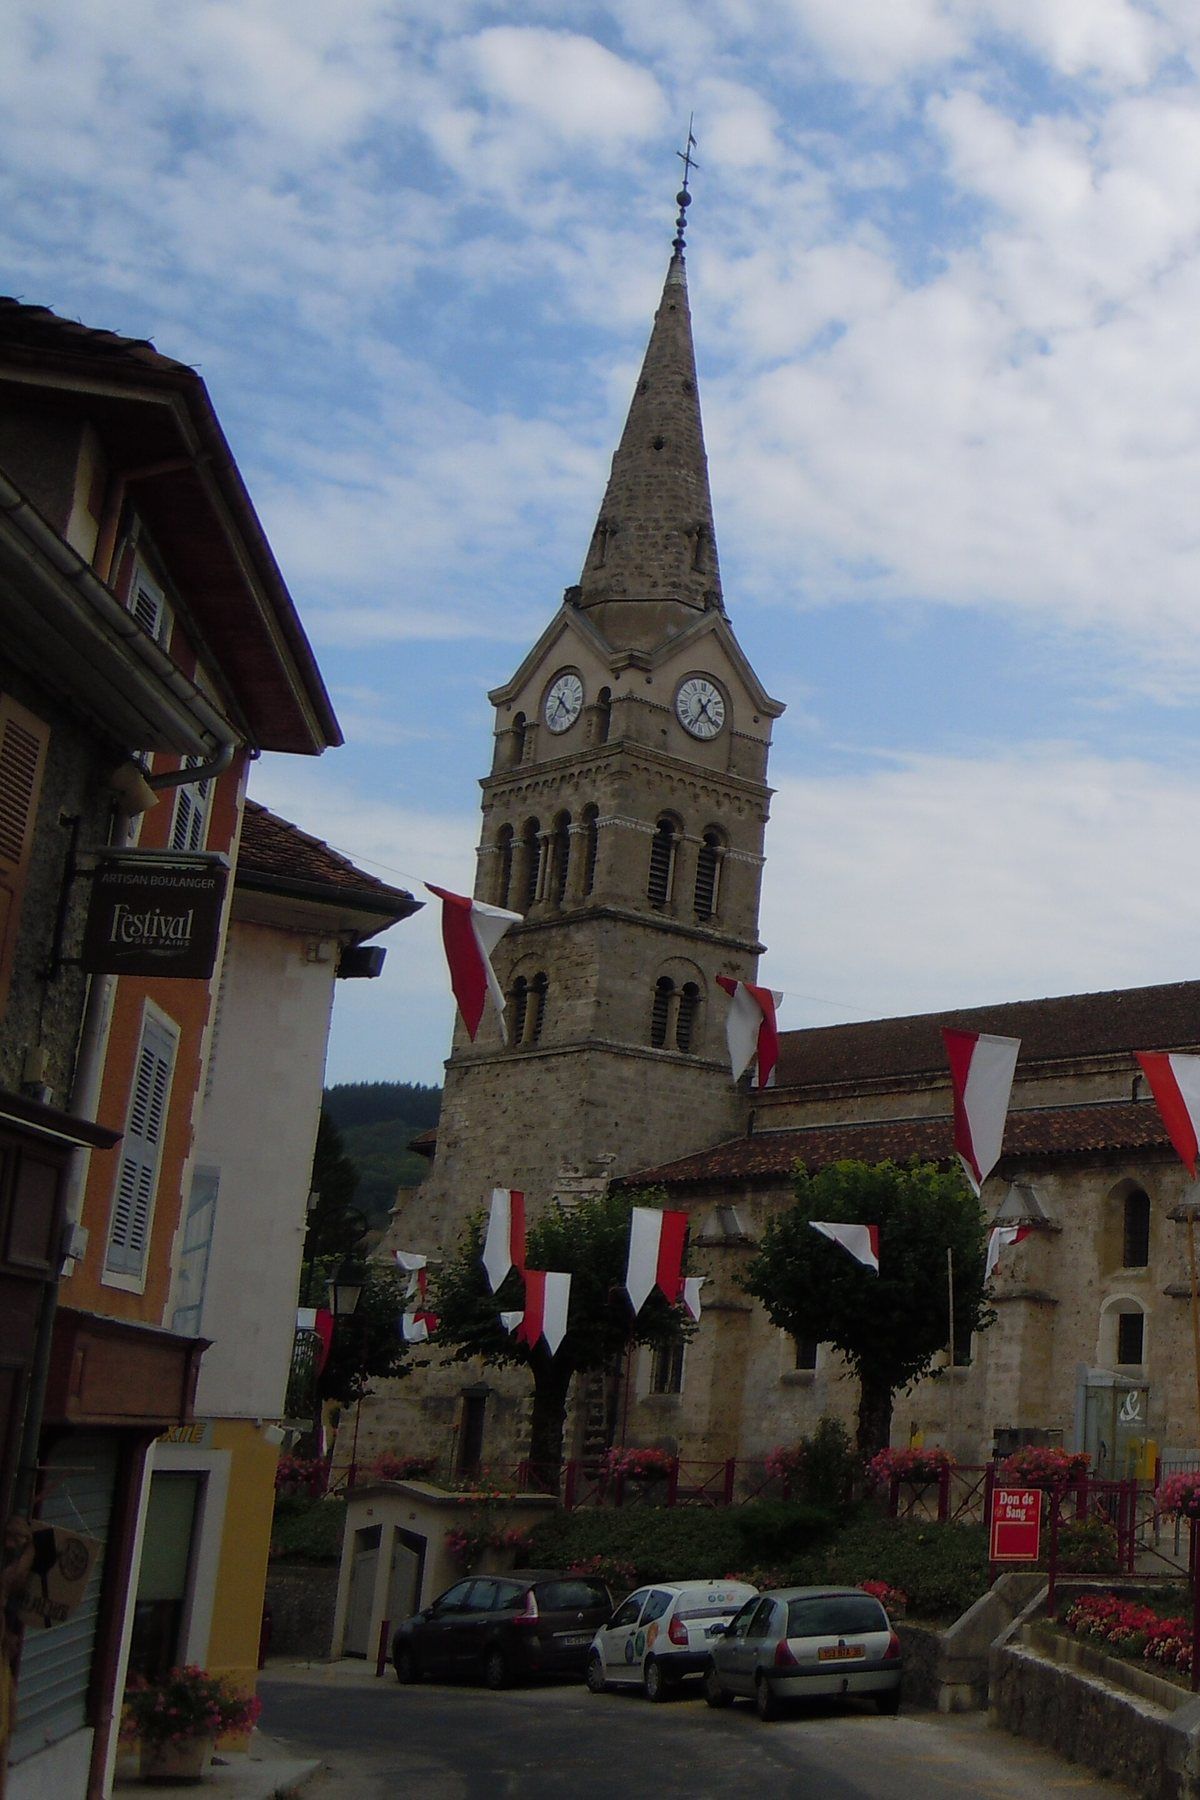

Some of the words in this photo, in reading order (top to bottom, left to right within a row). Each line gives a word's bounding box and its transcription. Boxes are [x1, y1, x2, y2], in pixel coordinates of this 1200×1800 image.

[102, 873, 148, 885] ARTISAN
[150, 875, 215, 889] BOULANGER
[109, 903, 194, 943] Festival
[999, 1491, 1020, 1505] Don
[1022, 1492, 1035, 1505] de
[1005, 1505, 1027, 1521] Sang
